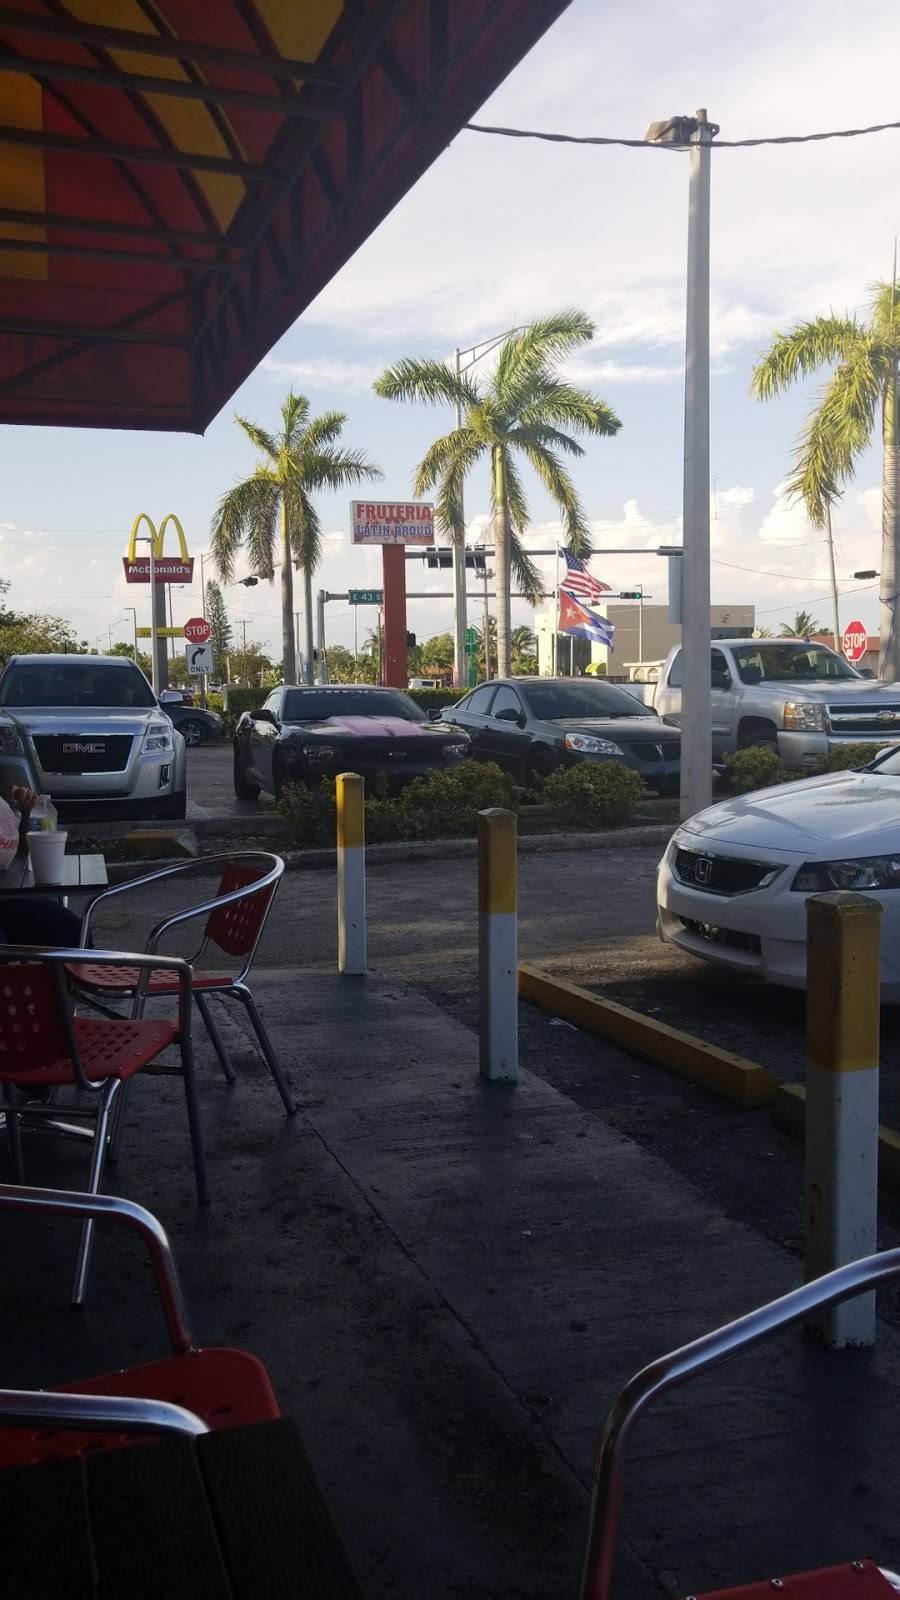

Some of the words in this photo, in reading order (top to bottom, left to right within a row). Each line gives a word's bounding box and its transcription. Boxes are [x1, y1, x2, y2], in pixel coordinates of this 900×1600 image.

[357, 503, 432, 521] FRUTERIA
[357, 524, 390, 537] LATIN
[394, 524, 432, 537] PROUD
[128, 565, 191, 574] McDonald's
[186, 625, 209, 636] STOP
[844, 633, 866, 648] STOP
[190, 665, 209, 673] ONLY
[63, 743, 106, 753] GMC
